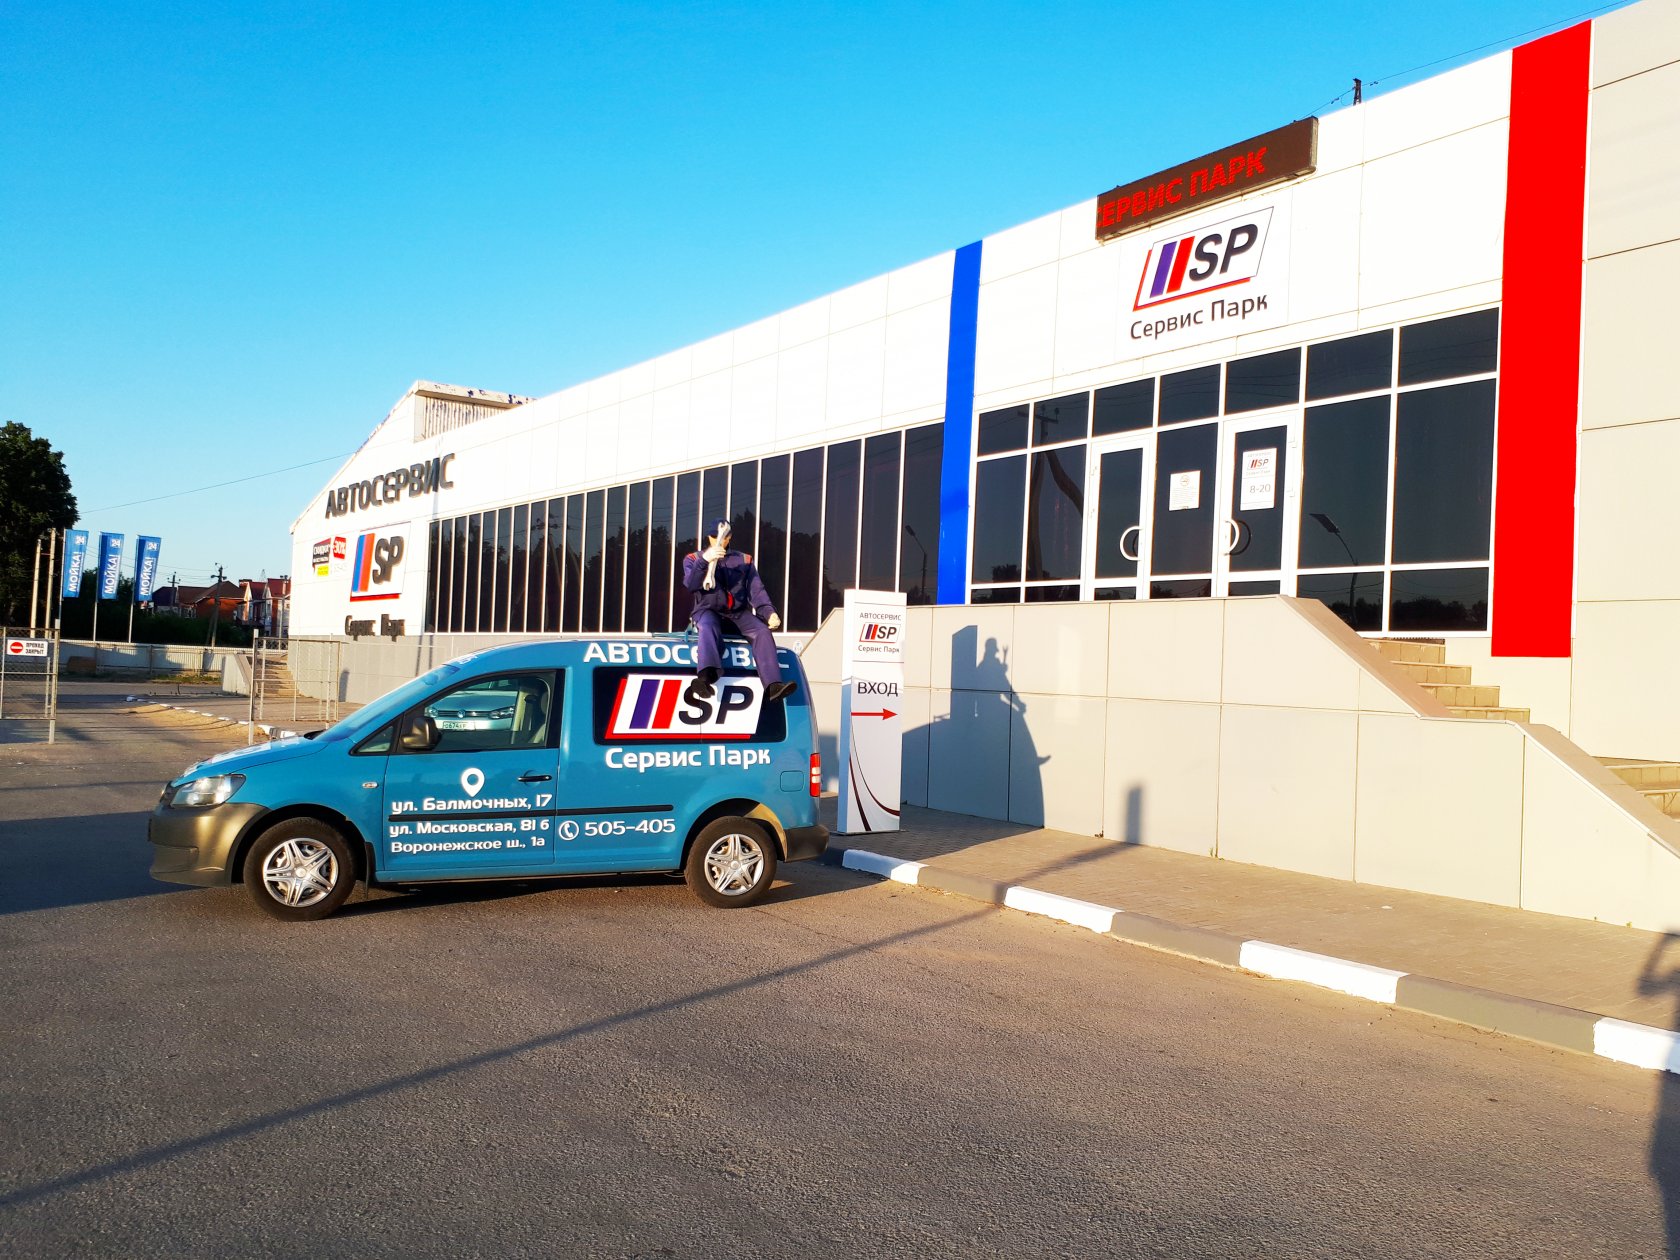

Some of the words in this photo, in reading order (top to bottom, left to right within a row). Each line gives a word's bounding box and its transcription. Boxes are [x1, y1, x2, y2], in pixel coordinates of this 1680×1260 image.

[1189, 146, 1268, 197] ПАРК
[1188, 223, 1259, 282] SP
[1130, 309, 1203, 340] Сервис
[1211, 294, 1268, 323] Парк
[325, 452, 456, 519] АВТОСЕРВИС
[1249, 483, 1271, 494] 8-20
[68, 551, 82, 592] МОЙКА!
[104, 554, 119, 594] МОЙКА!
[372, 535, 405, 585] SP
[140, 556, 154, 596] МОЙКА!
[859, 612, 902, 621] АВТОСЕРВИС
[877, 626, 898, 640] SP
[858, 645, 882, 653] Сервис
[883, 646, 900, 654] Парк
[857, 682, 899, 697] ВХОД
[678, 684, 755, 726] SP
[605, 748, 702, 773] Сервис
[708, 745, 772, 770] Парк
[391, 800, 418, 815] ул.
[422, 797, 532, 811] Балмочных,
[535, 793, 553, 807] 17
[389, 824, 413, 838] ул.
[417, 821, 517, 834] Московская,
[584, 818, 676, 837] 505-405
[391, 840, 502, 855] Воронежское
[506, 839, 527, 849] ш.,
[530, 836, 546, 847] 1а
